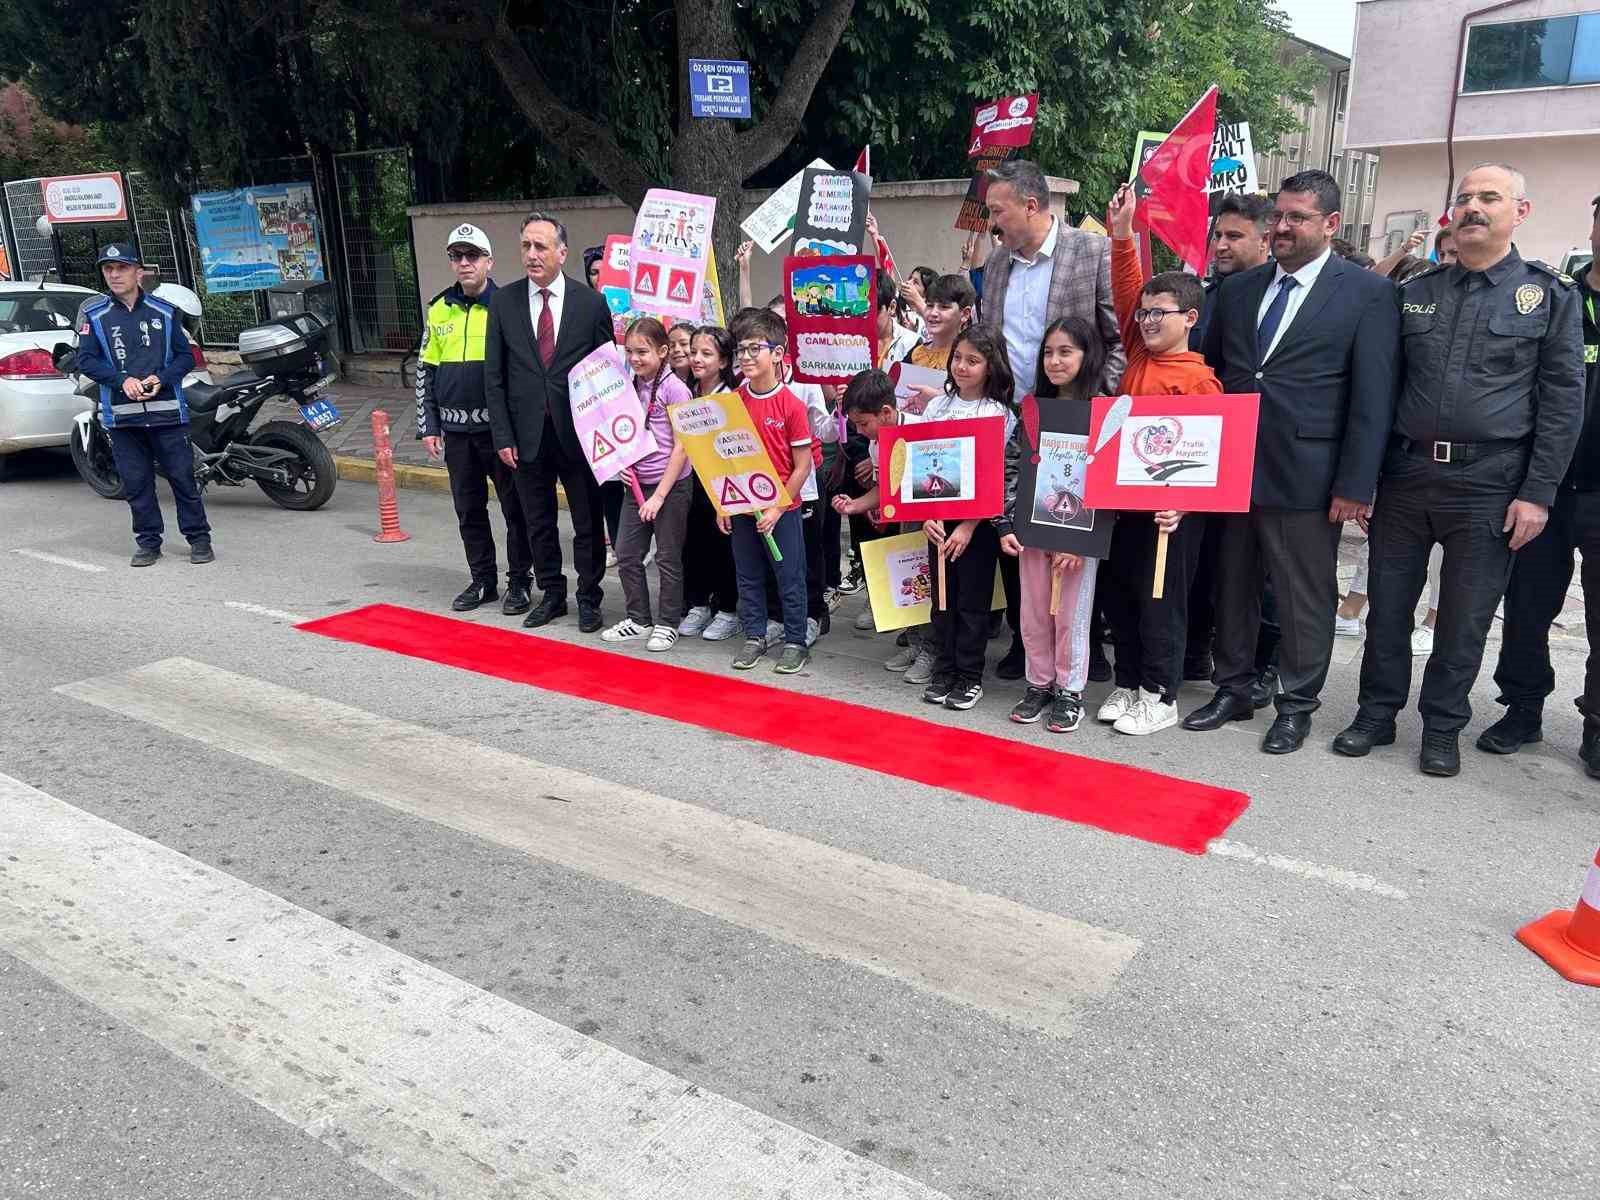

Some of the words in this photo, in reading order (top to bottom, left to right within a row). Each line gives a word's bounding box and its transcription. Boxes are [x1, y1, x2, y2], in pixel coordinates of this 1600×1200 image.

[716, 65, 746, 74] OTOPARK
[805, 336, 866, 347] CAMLARDAN
[800, 360, 871, 371] SARKMAYALIM
